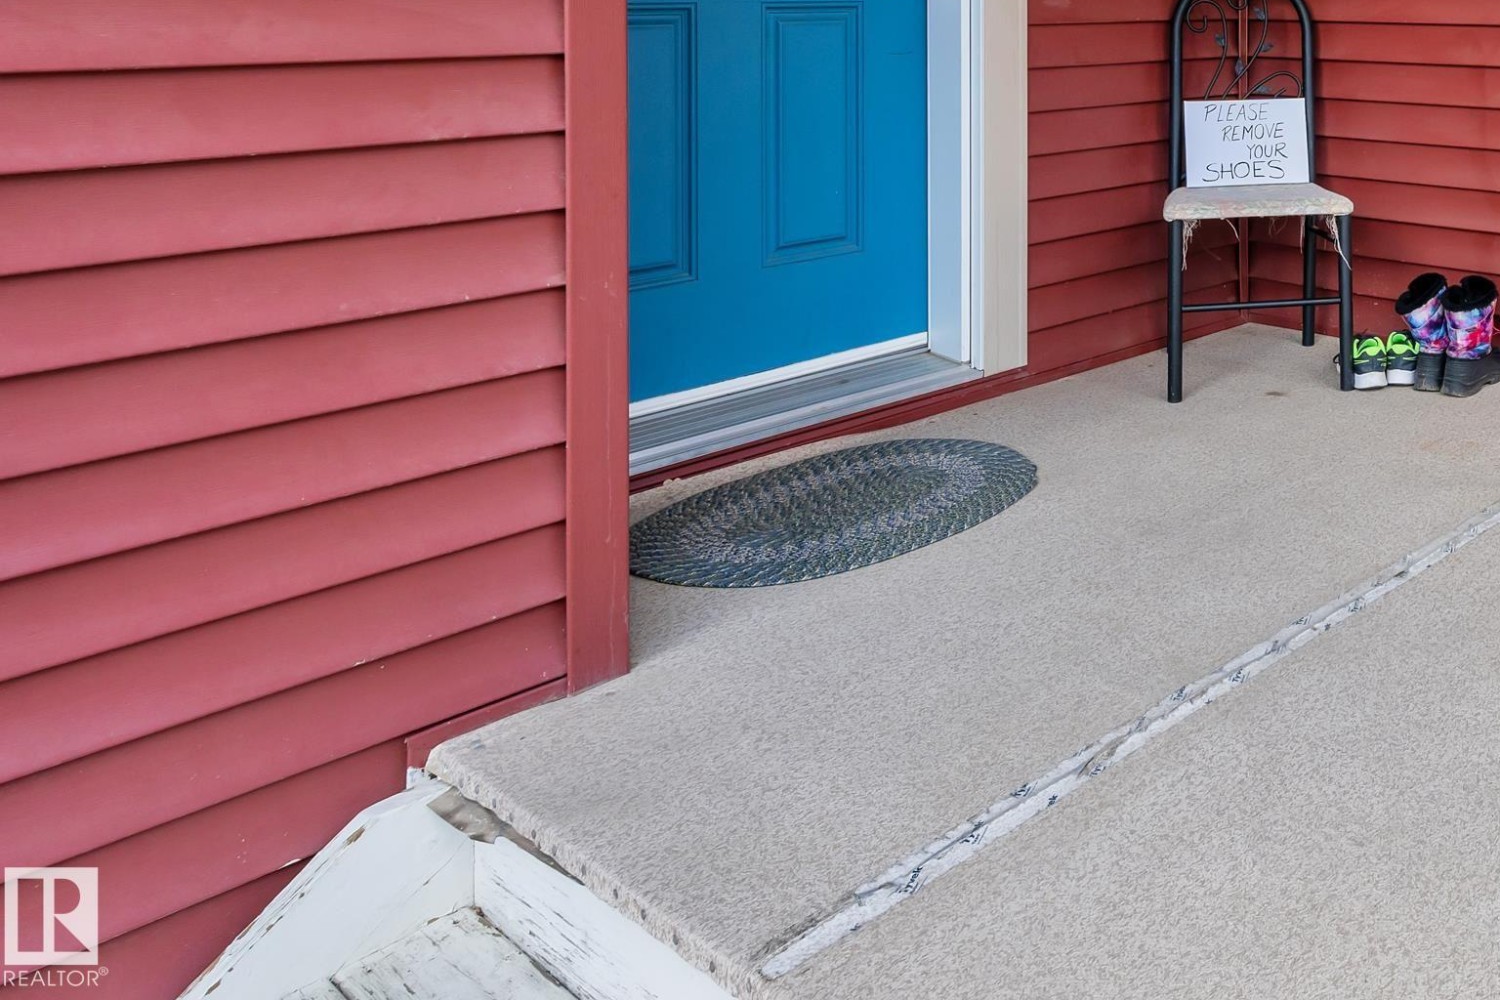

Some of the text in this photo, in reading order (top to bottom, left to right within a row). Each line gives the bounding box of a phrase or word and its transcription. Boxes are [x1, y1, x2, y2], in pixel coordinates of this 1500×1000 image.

[1204, 102, 1270, 122] PLEASE
[1221, 122, 1285, 142] REMOVE
[1246, 142, 1289, 160] YOUR
[1202, 160, 1286, 183] SHOES
